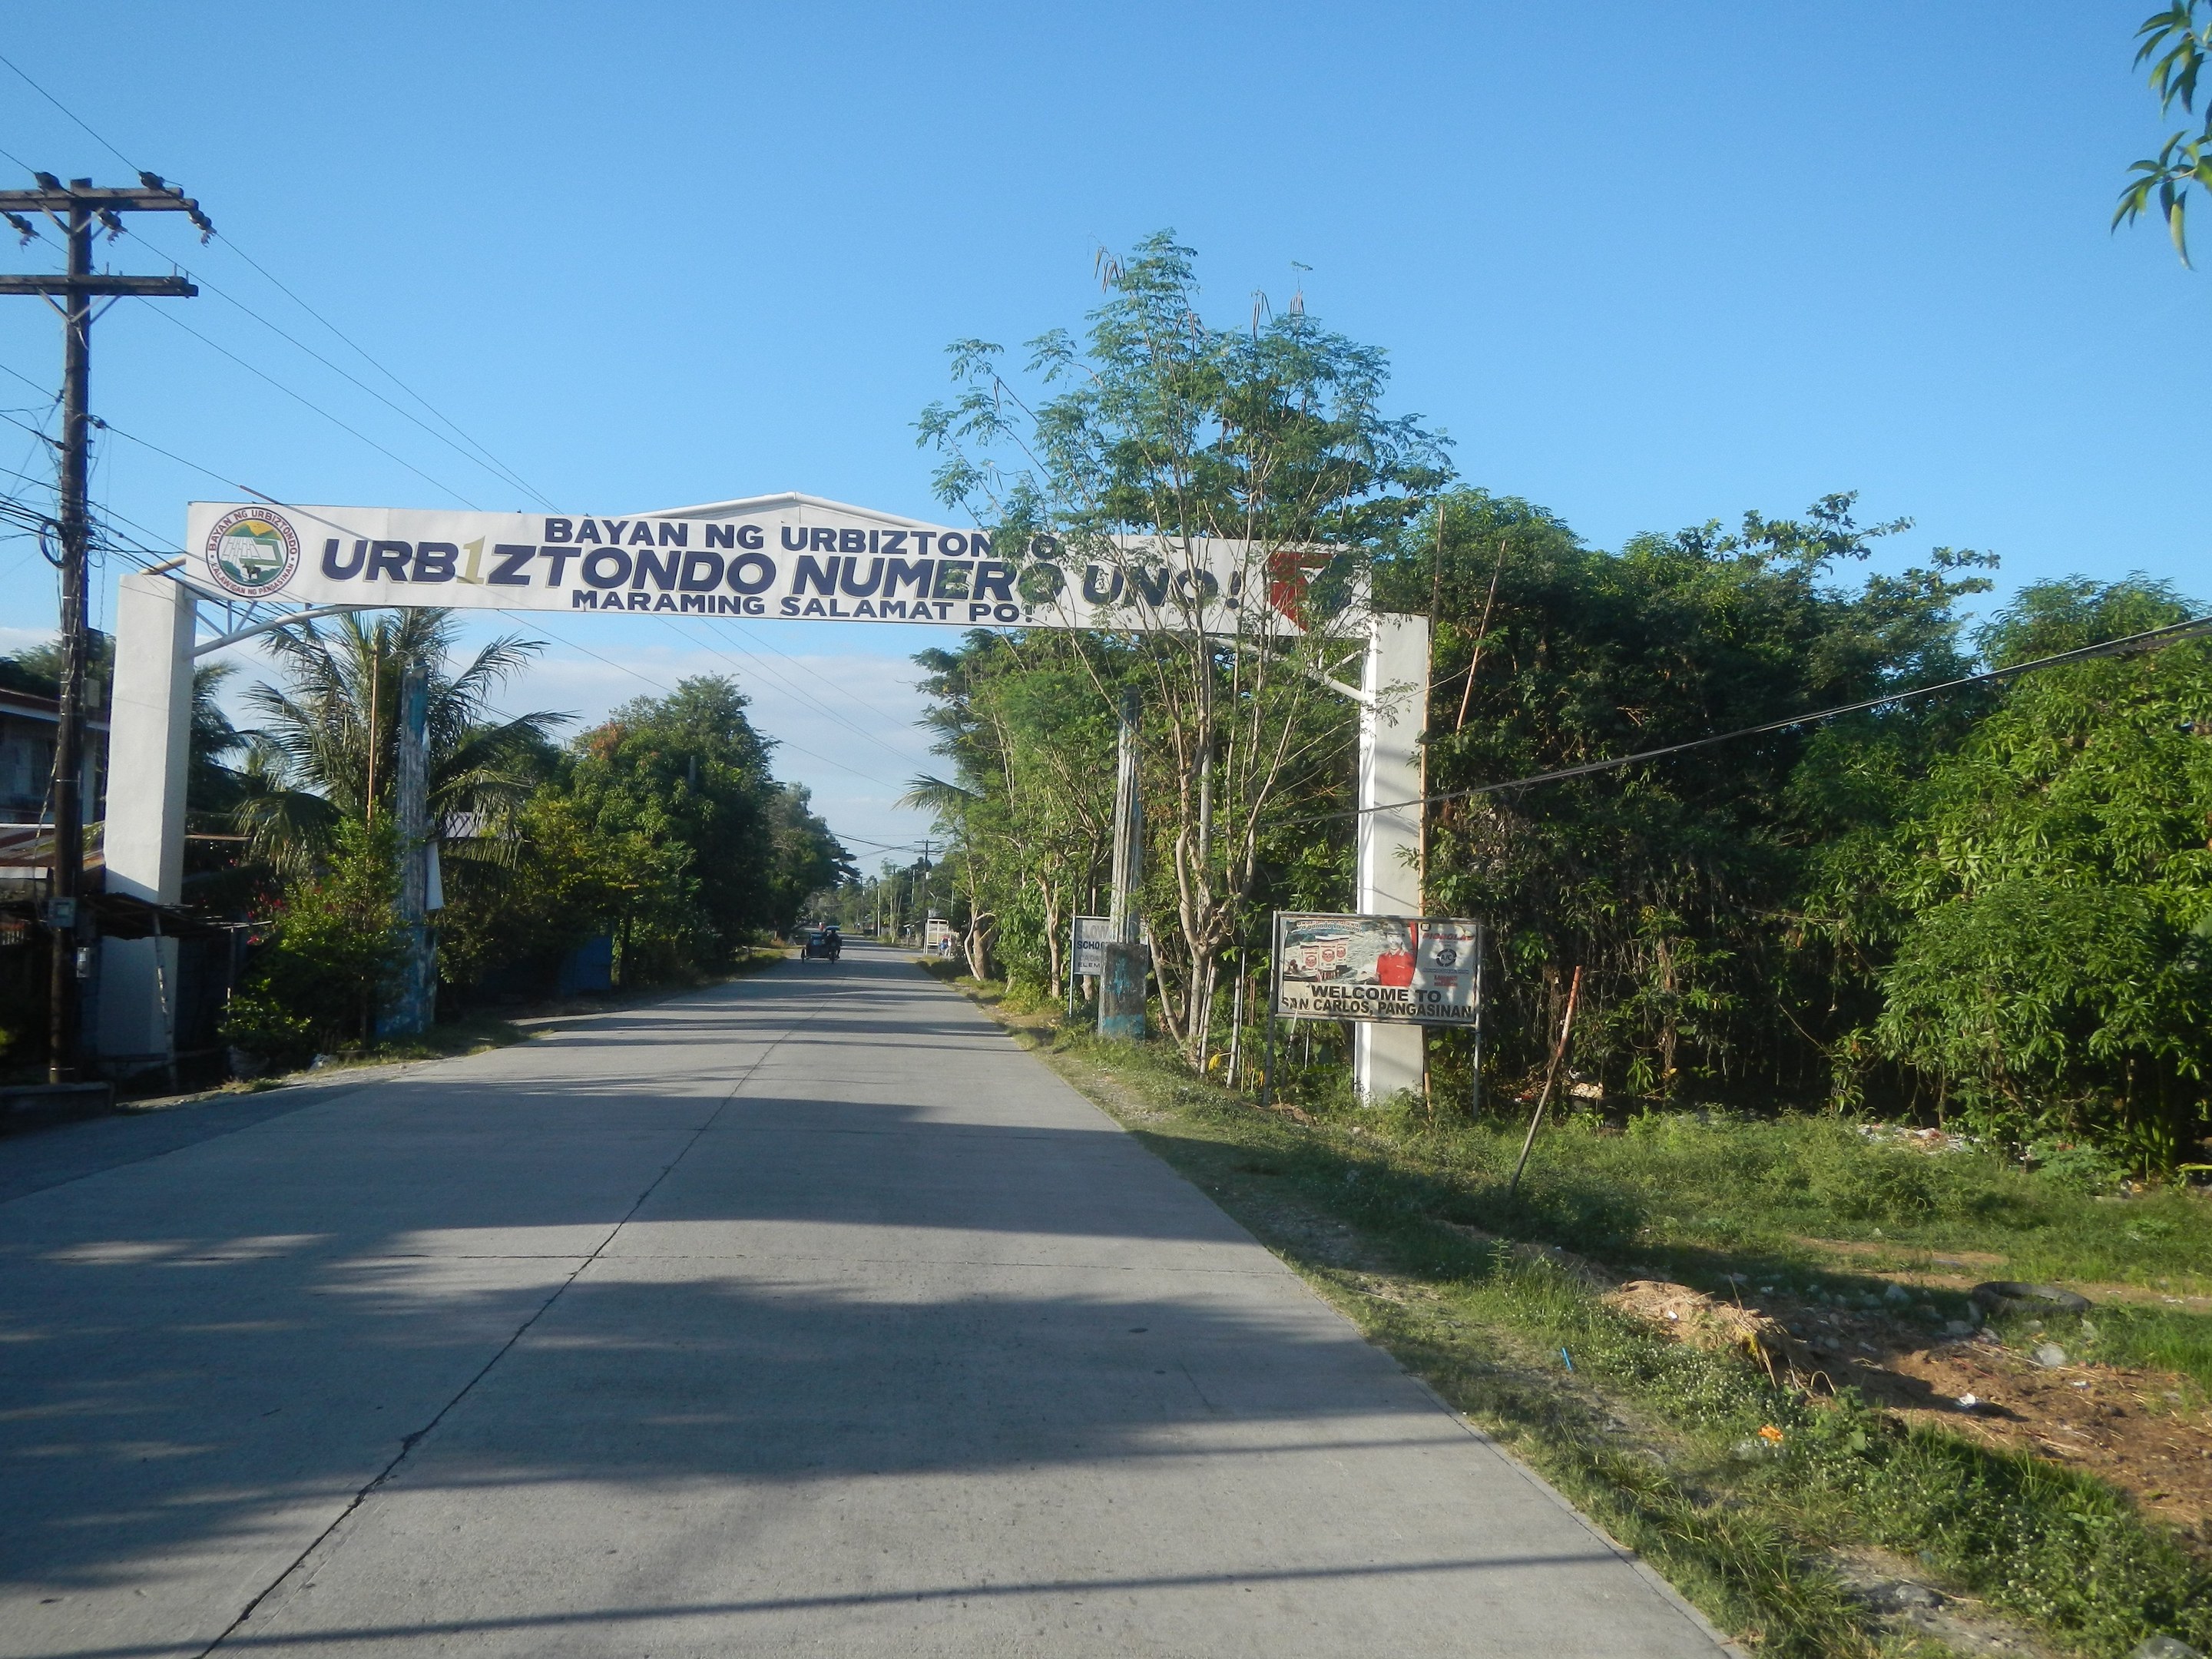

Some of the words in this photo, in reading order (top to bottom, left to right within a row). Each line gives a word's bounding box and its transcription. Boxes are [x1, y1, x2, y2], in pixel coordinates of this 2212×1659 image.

[209, 518, 233, 551] BAYAN
[233, 509, 248, 520] NG
[251, 509, 298, 555] URBIZTONDO
[545, 518, 688, 547] BAYAN
[705, 524, 764, 550] NG
[781, 526, 1067, 560] URBIZTONO
[258, 563, 295, 595] PANGASINAN
[320, 535, 777, 594] URB1ZTONDO
[790, 555, 1066, 604] NUMERO
[572, 589, 765, 615] MARAMING
[780, 596, 954, 621] SALAMAT
[1281, 996, 1310, 1010] SAN
[1313, 998, 1373, 1016] CARLOS,
[1378, 1001, 1472, 1018] PANGASINAN
[1310, 985, 1409, 1002] WELCOME
[1415, 989, 1442, 1003] TO
